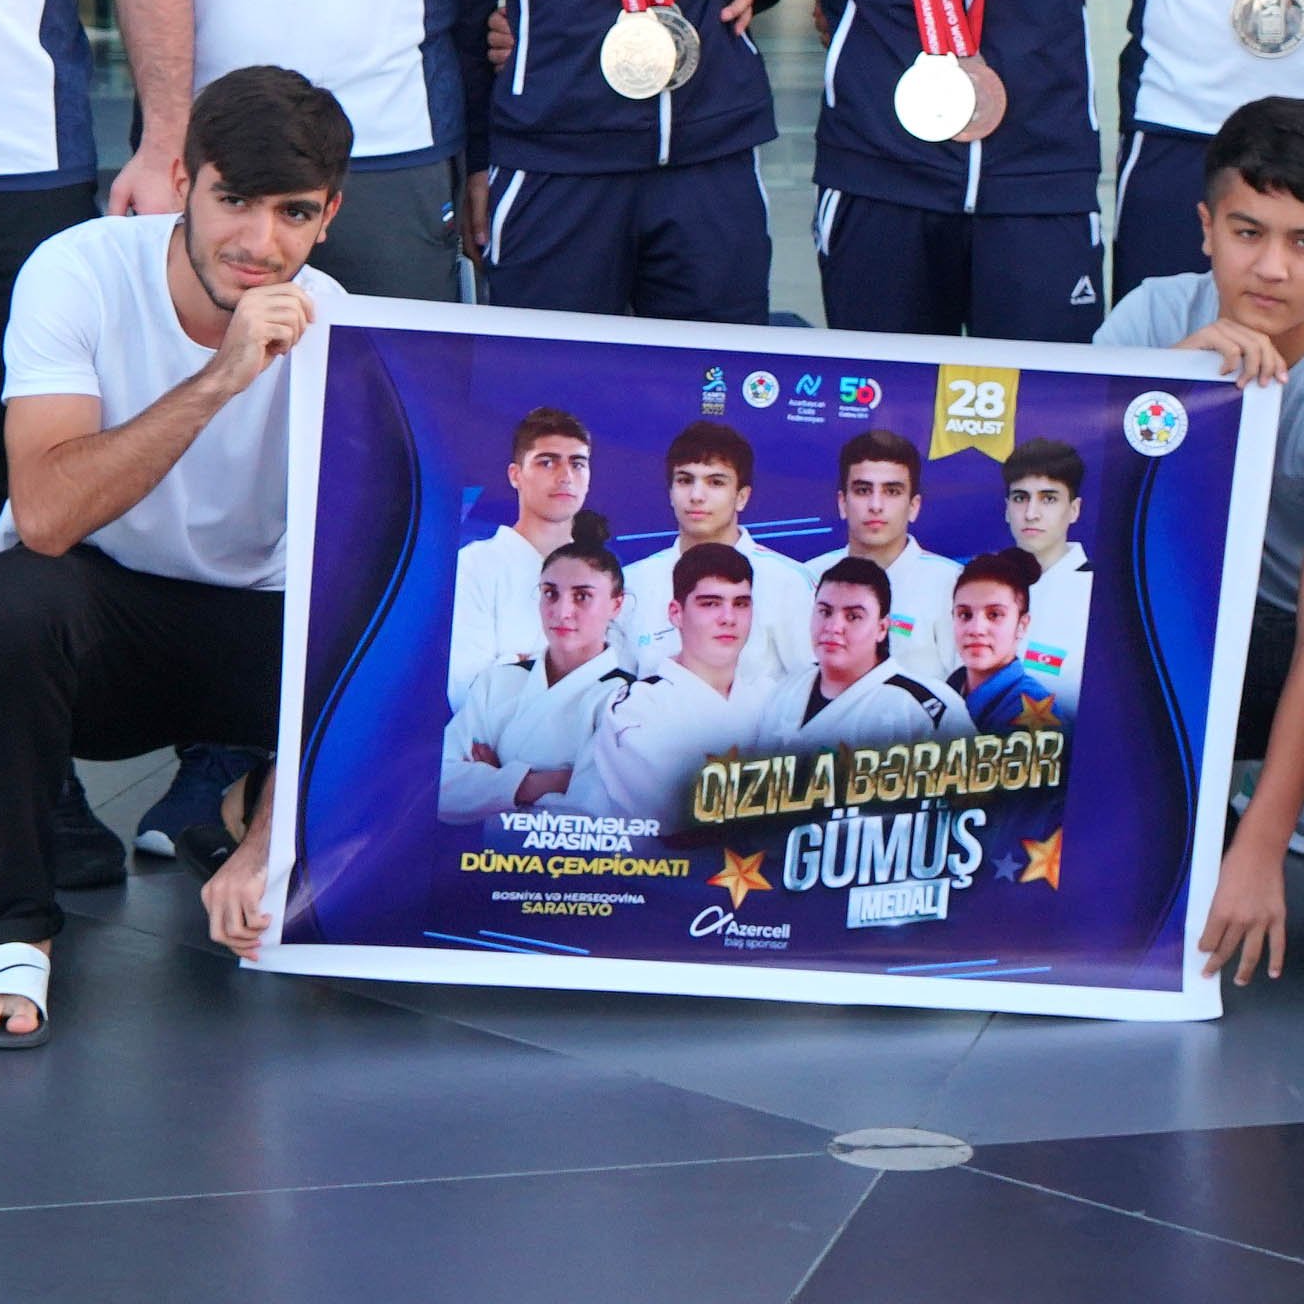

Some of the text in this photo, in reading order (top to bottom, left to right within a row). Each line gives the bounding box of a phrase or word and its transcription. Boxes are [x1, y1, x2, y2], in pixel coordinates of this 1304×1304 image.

[948, 24, 969, 59] WORL
[947, 380, 1005, 419] 28
[944, 418, 1005, 436] AVQUST
[694, 730, 1064, 824] QIZILA BƏRABƏR
[499, 810, 660, 837] YENİYETMƏLƏR
[522, 832, 633, 852] ARASINDA
[783, 800, 987, 891] GÜMÜŞ
[460, 849, 690, 879] DÜNYA ÇEMPİONATI
[491, 890, 646, 905] BOSNİYA VƏ HERSEQOVİNA
[521, 901, 614, 917] SARAYEVO
[859, 884, 940, 922] MEDAL
[725, 921, 791, 939] Azercell
